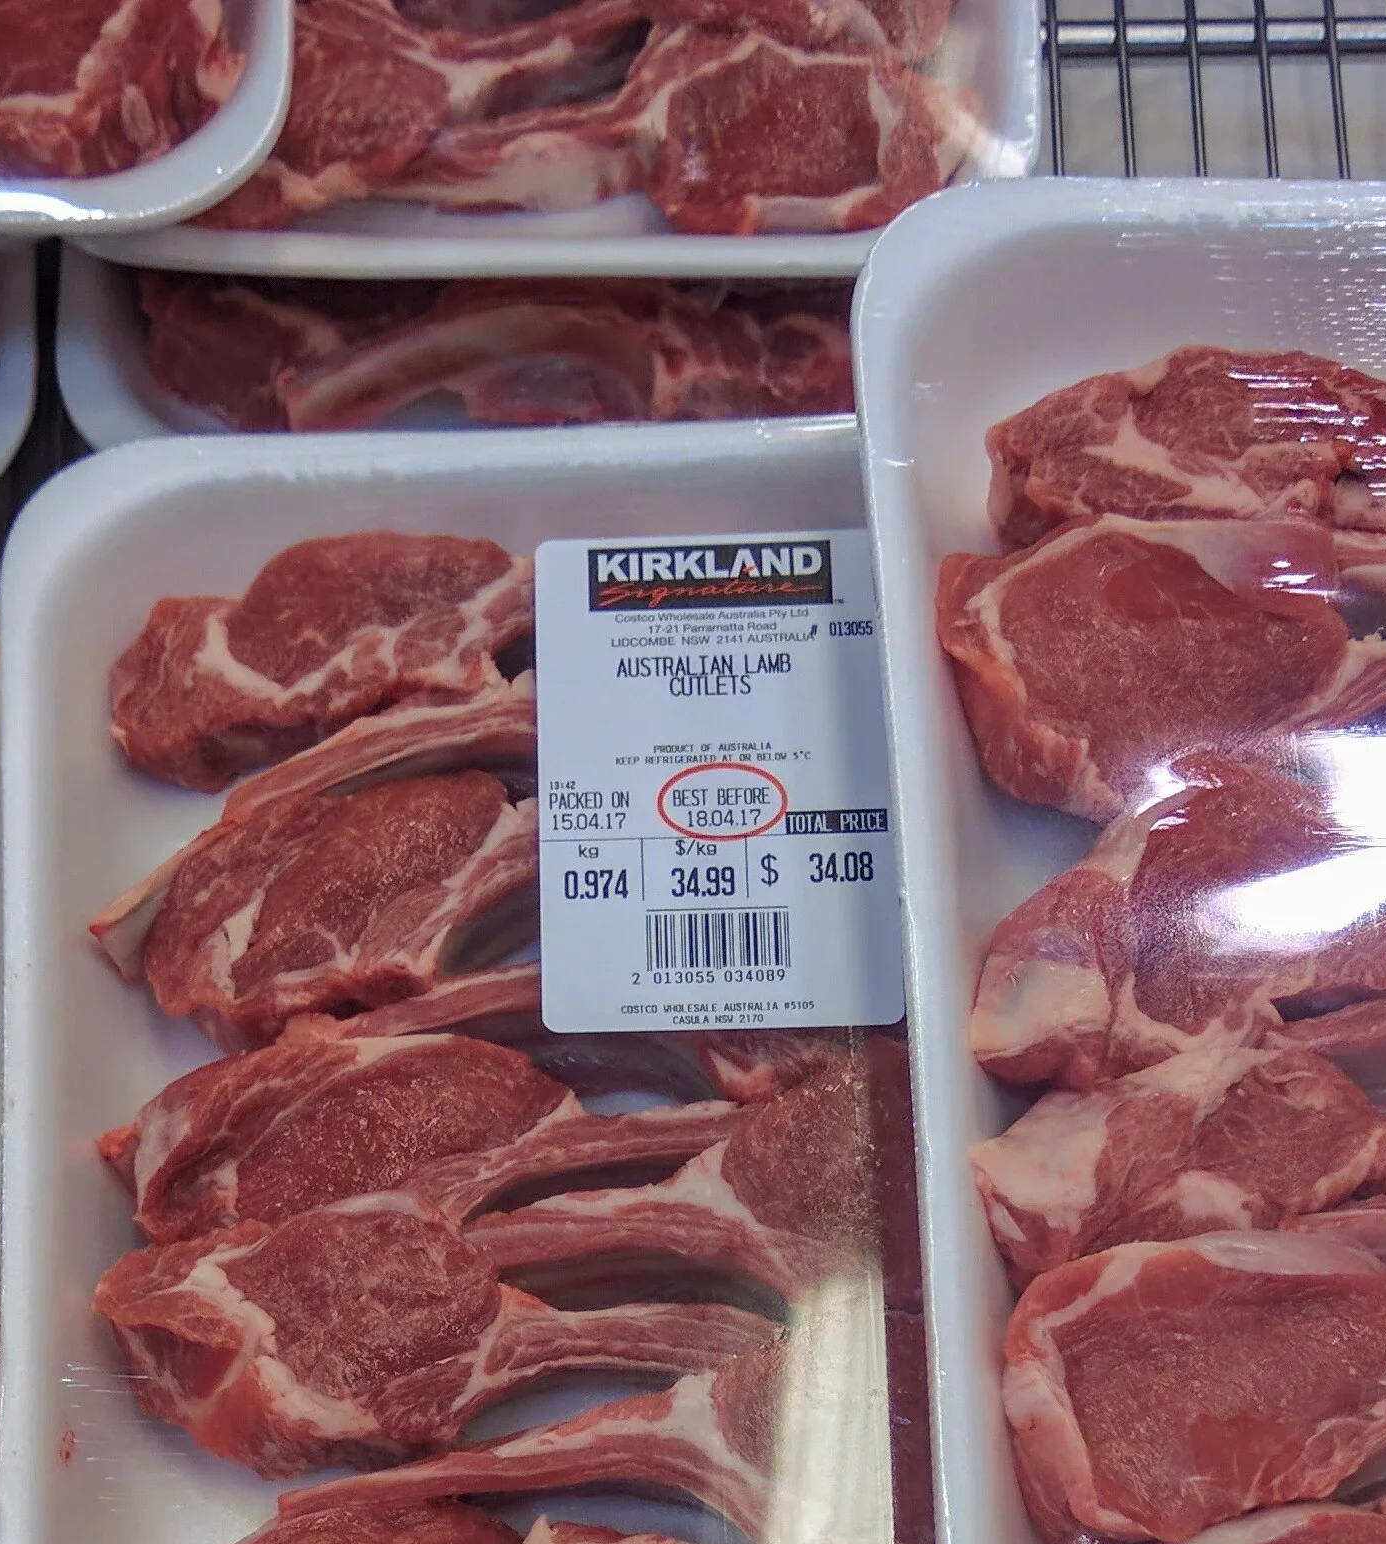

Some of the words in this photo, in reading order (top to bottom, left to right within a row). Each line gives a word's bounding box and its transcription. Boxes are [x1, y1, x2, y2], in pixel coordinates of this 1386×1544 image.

[597, 546, 822, 582] KIRKLAND
[597, 579, 822, 608] Signature
[614, 613, 655, 624] Costco
[657, 611, 714, 623] Wholesale
[717, 610, 766, 621] Australia
[768, 609, 787, 620] Pty
[787, 608, 809, 617] Ltd
[649, 625, 679, 634] 17-21
[683, 622, 744, 633] Parramatta
[747, 621, 777, 631] Road
[829, 621, 873, 636] 013055
[611, 637, 676, 648] LIDCOMBE
[682, 636, 710, 646] NSW
[717, 635, 743, 644] 2141
[747, 632, 815, 643] AUSTRALIA
[617, 655, 733, 678] AUSTRALIAN
[744, 653, 791, 674] LAMB
[670, 675, 752, 696] CUTLETS
[654, 744, 694, 753] PRODUCT
[701, 744, 712, 752] OF
[718, 742, 771, 751] AUSTRALIA
[615, 756, 641, 765] KEEP
[645, 754, 717, 764] REFRIGERATED
[721, 754, 733, 763] AT
[739, 753, 751, 762] OR
[756, 752, 787, 761] BELOW
[549, 781, 576, 790] 13:42
[549, 791, 603, 810] PACKED
[611, 791, 629, 808] ON
[672, 788, 708, 807] BEST
[717, 786, 771, 805] BEFORE
[552, 813, 626, 831] 15.04.17
[687, 809, 761, 827] 18.04.17
[787, 812, 831, 833] TOTAL
[839, 810, 886, 831] PRICE
[578, 845, 599, 859] kg
[675, 839, 717, 856] $/kg
[761, 853, 779, 886] $
[809, 851, 874, 882] 34.08
[564, 870, 628, 900] 0.974
[671, 867, 735, 897] 34.99
[632, 973, 641, 984] 2
[654, 971, 715, 984] 013055
[724, 969, 786, 982] 034089
[621, 1005, 658, 1014] COSTCO
[663, 1004, 717, 1013] WHOLESALE
[724, 1002, 778, 1011] AUSTRALIA
[673, 1015, 709, 1025] CASULA
[715, 1015, 734, 1024] NSW
[739, 1014, 763, 1023] 2170
